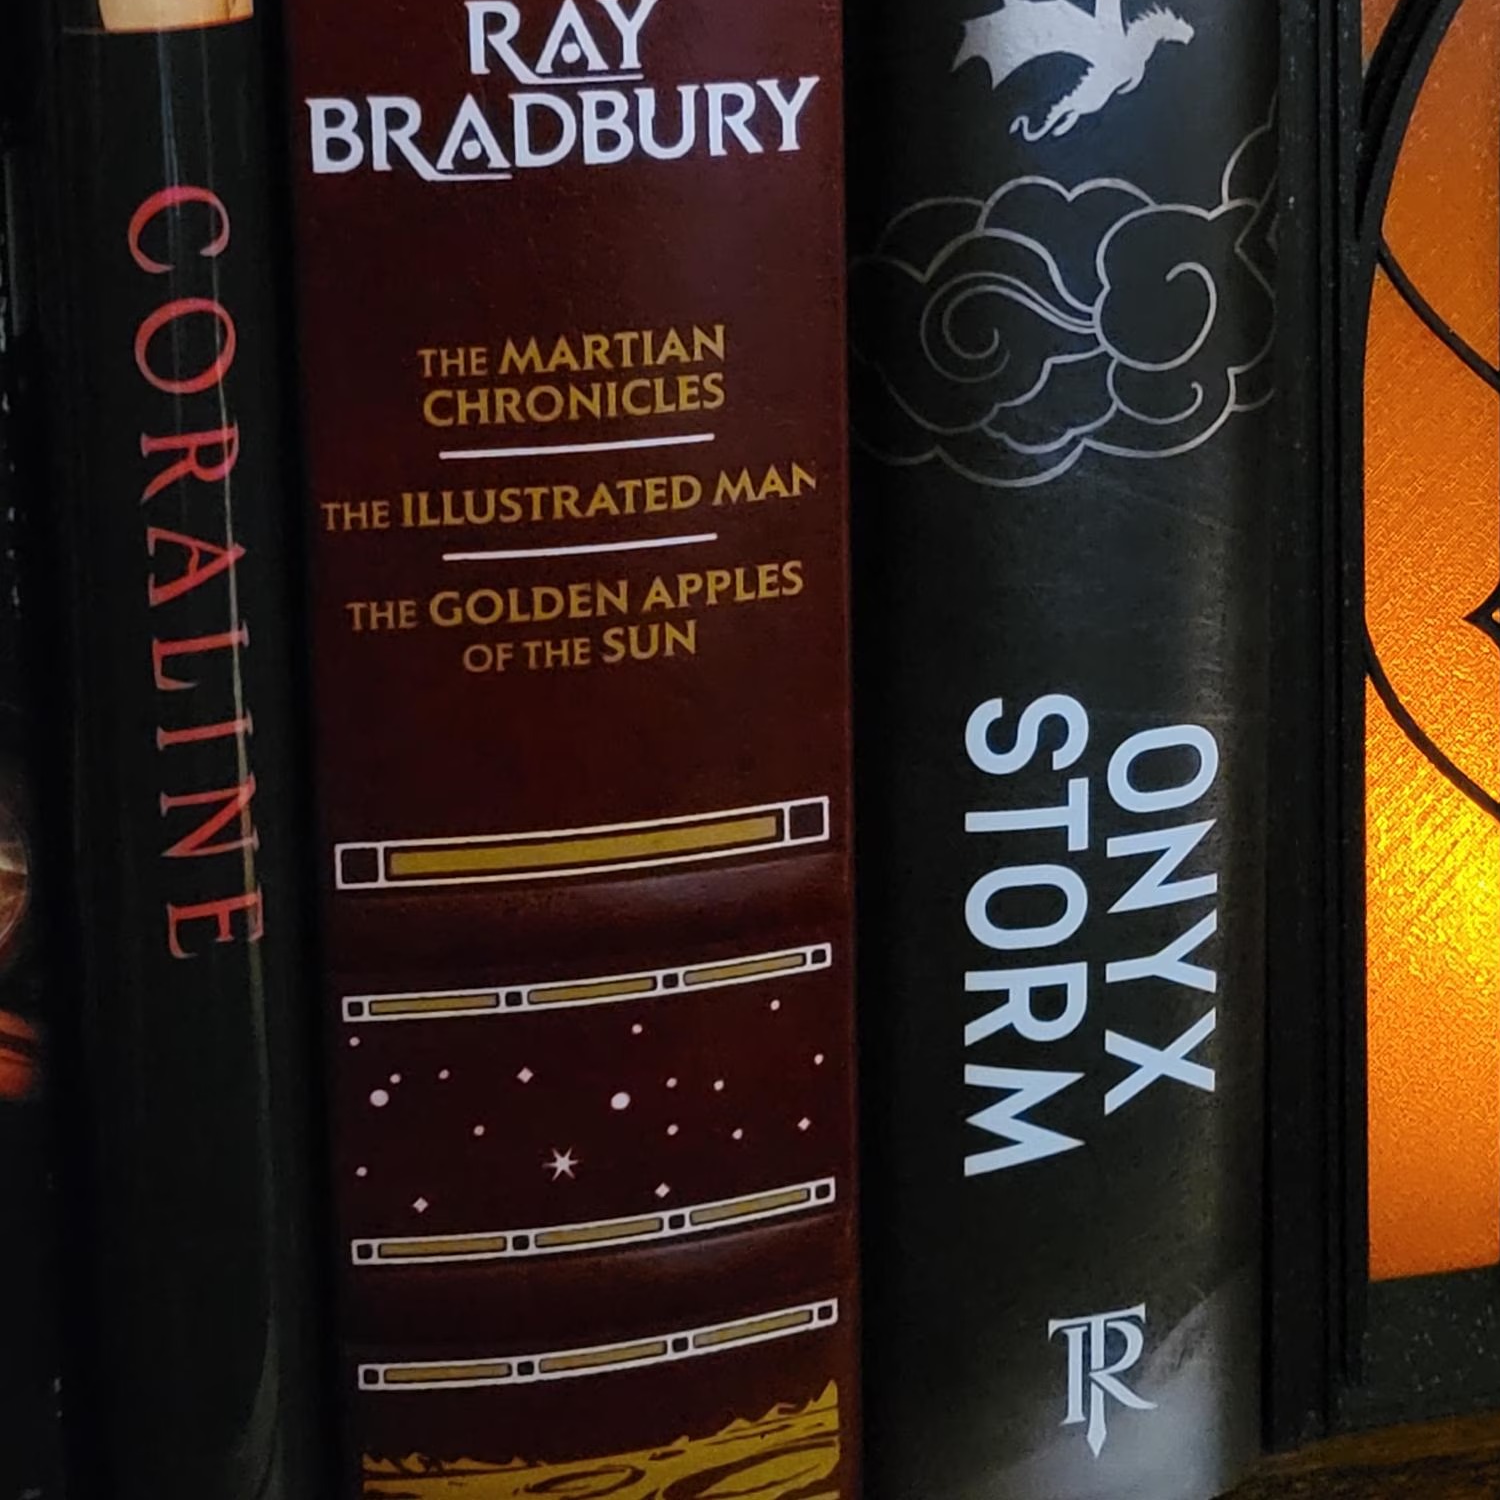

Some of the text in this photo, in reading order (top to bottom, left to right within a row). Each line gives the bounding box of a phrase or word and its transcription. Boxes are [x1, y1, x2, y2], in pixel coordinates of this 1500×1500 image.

[305, 75, 820, 182] BRADBURY
[418, 325, 726, 377] THE MARTIAN
[423, 372, 726, 427] CHRONICLES
[321, 461, 817, 531] THE ILLUSTRATED MAN
[127, 184, 266, 960] CORALINE
[346, 561, 803, 631] THE GOLDEN APPLES
[463, 621, 697, 672] OF THE SUN
[964, 693, 1090, 1177] STORM
[1104, 723, 1220, 1116] ONYX
